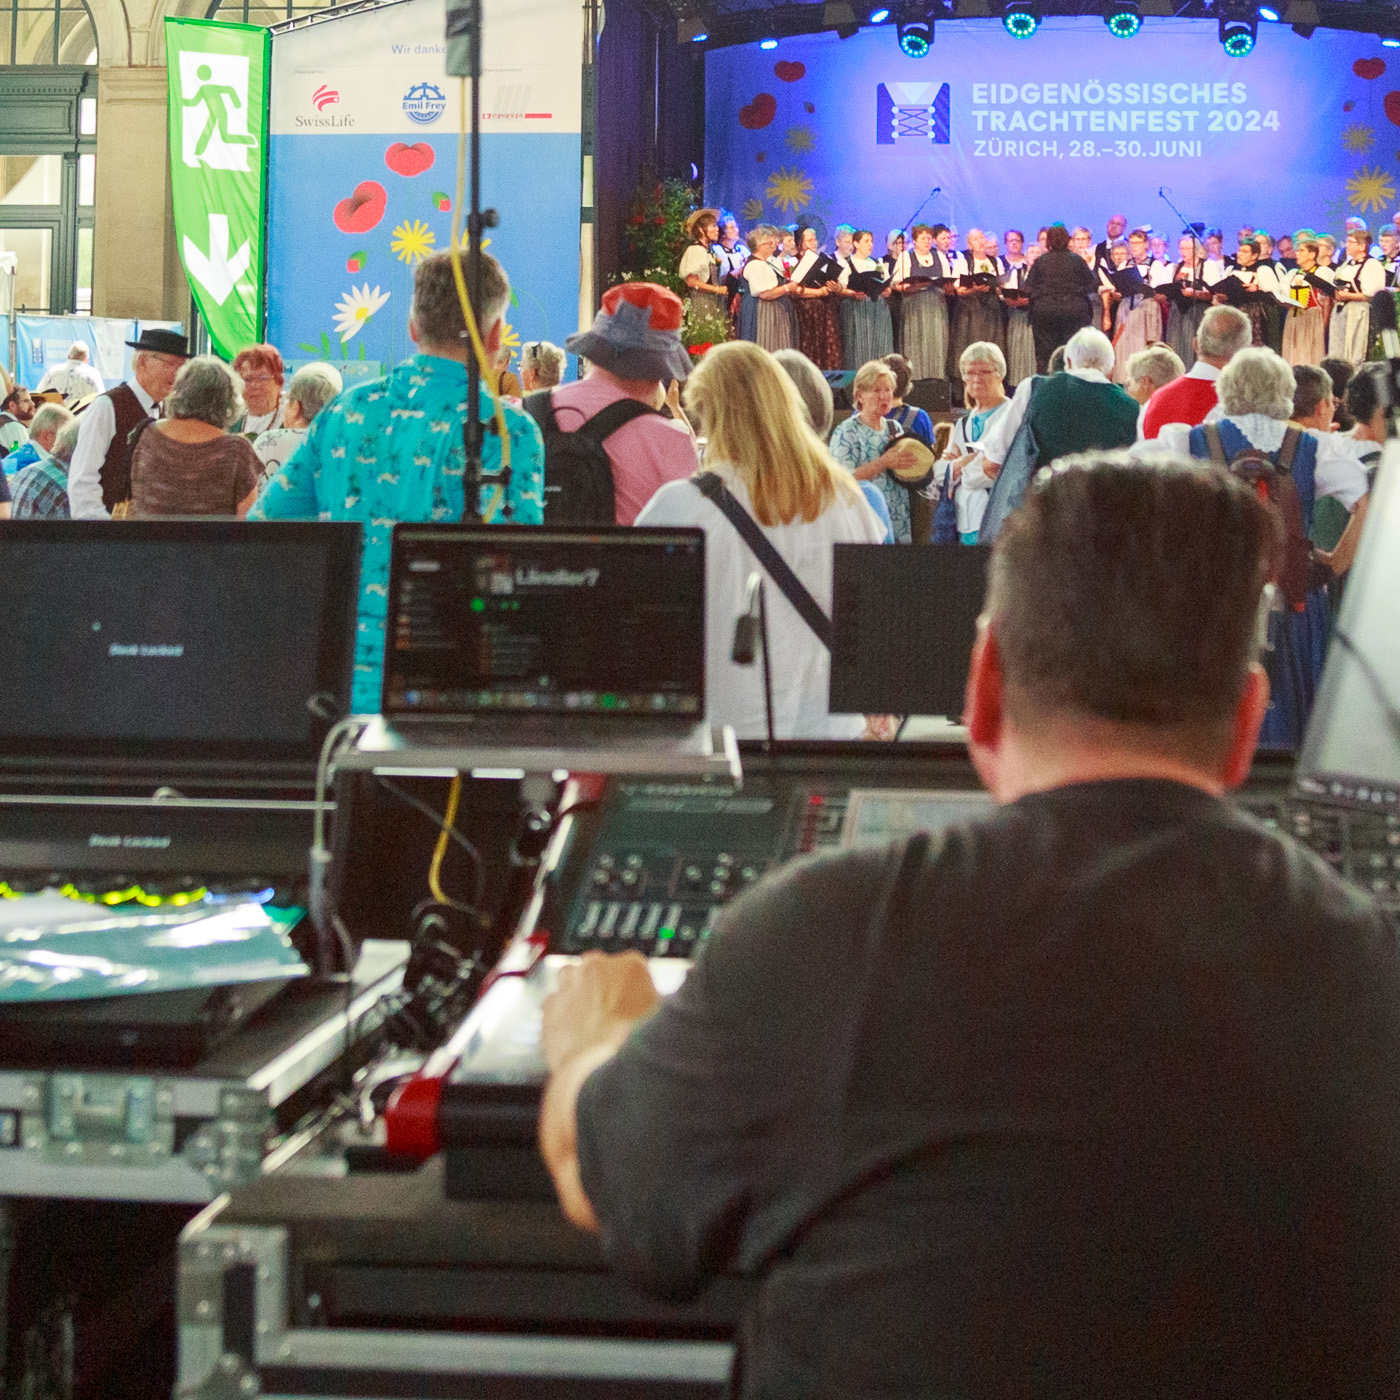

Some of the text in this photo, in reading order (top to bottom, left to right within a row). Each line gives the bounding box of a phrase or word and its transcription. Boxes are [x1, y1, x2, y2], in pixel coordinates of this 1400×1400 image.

[391, 43, 447, 55] Wir danke
[972, 79, 1247, 105] EIDGENÖSSISCHES
[402, 101, 446, 112] Emil Frey
[972, 110, 1281, 132] TRACHTENFEST 2024
[973, 137, 1064, 160] ZÜRICH,
